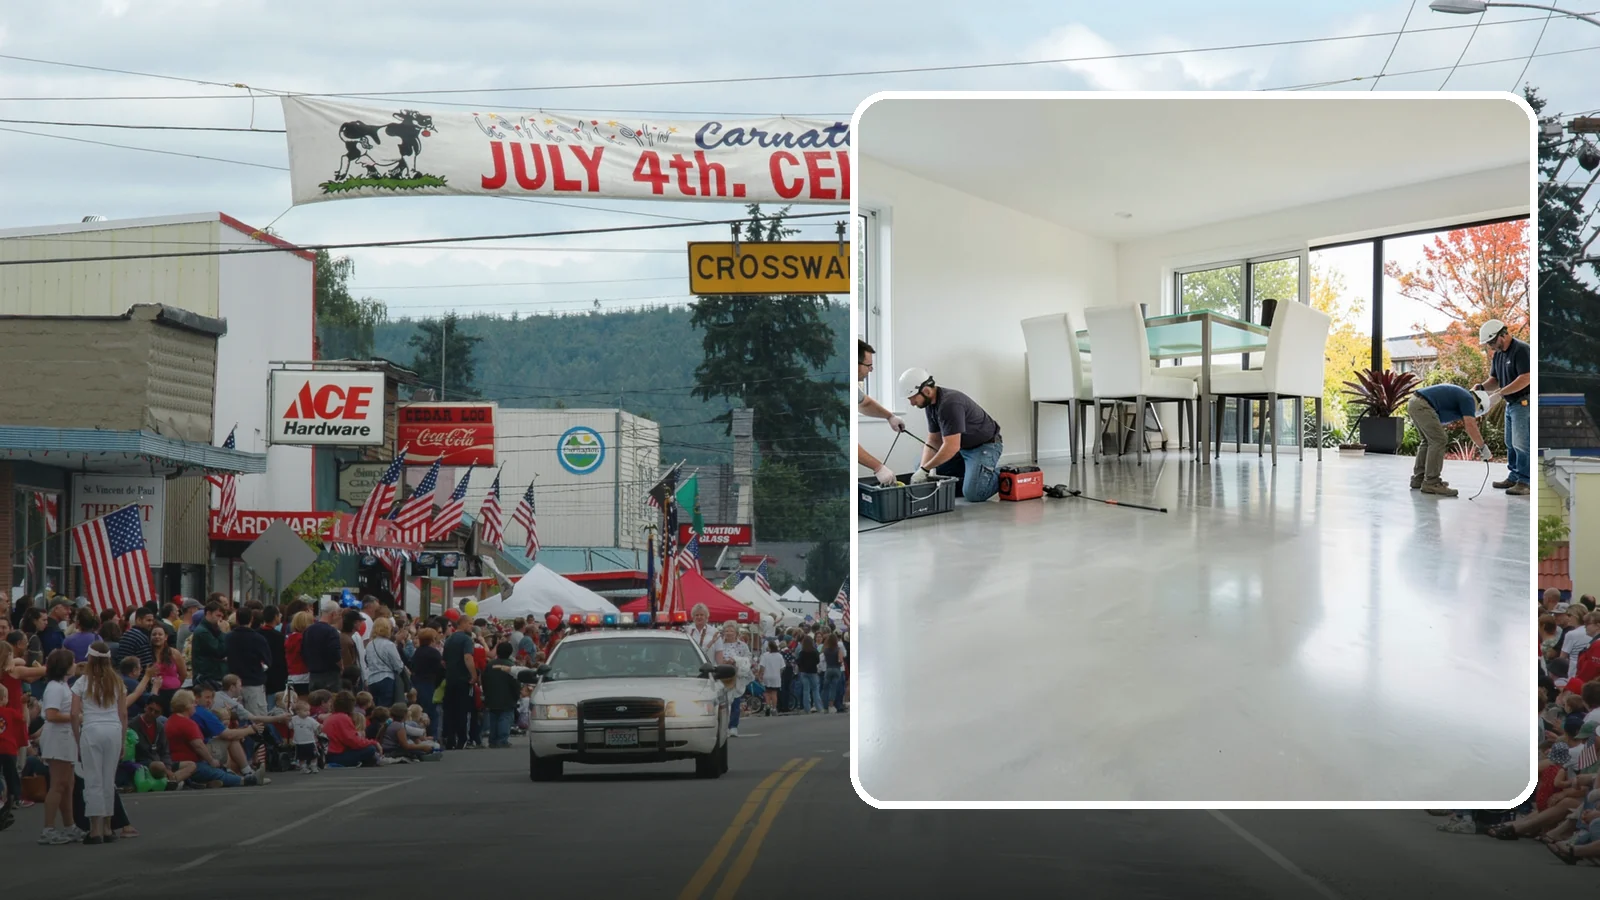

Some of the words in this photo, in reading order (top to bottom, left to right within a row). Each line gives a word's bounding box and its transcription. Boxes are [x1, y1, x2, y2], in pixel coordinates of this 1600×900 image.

[481, 140, 604, 192] JULY
[632, 150, 746, 197] 4th.
[697, 254, 850, 279] CROSSWA
[283, 380, 373, 420] ACE
[406, 409, 452, 421] CEDAR
[283, 421, 371, 436] Hardware
[354, 466, 388, 479] Simpl
[83, 485, 93, 494] St.
[95, 485, 124, 495] Vincent
[126, 485, 135, 495] de
[138, 486, 155, 495] Paul
[81, 503, 154, 522] THT
[212, 515, 331, 535] HARDARE
[688, 526, 741, 535] CRNATION
[699, 535, 731, 543] GLASS
